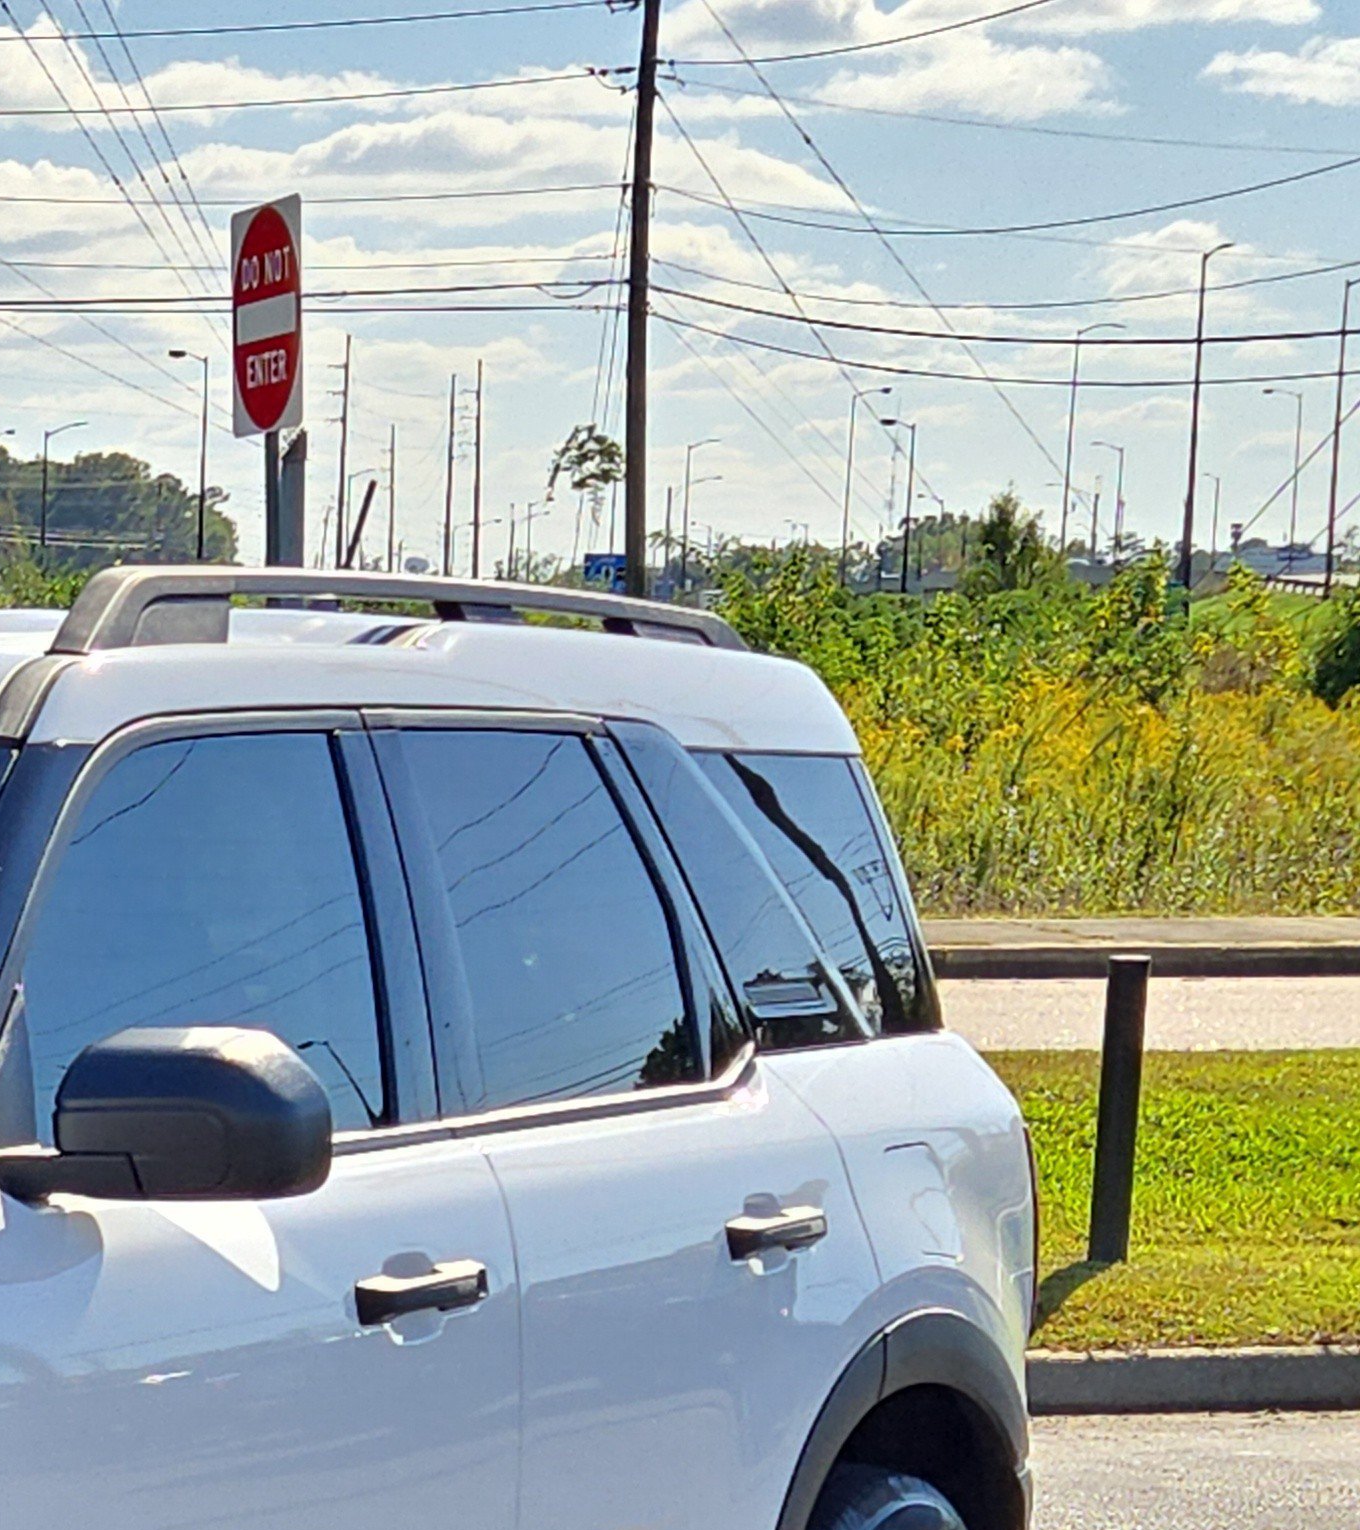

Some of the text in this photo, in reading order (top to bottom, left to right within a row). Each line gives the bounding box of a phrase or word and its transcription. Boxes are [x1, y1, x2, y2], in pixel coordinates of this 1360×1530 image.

[240, 246, 290, 292] DO NOT
[246, 349, 287, 389] ENTER
